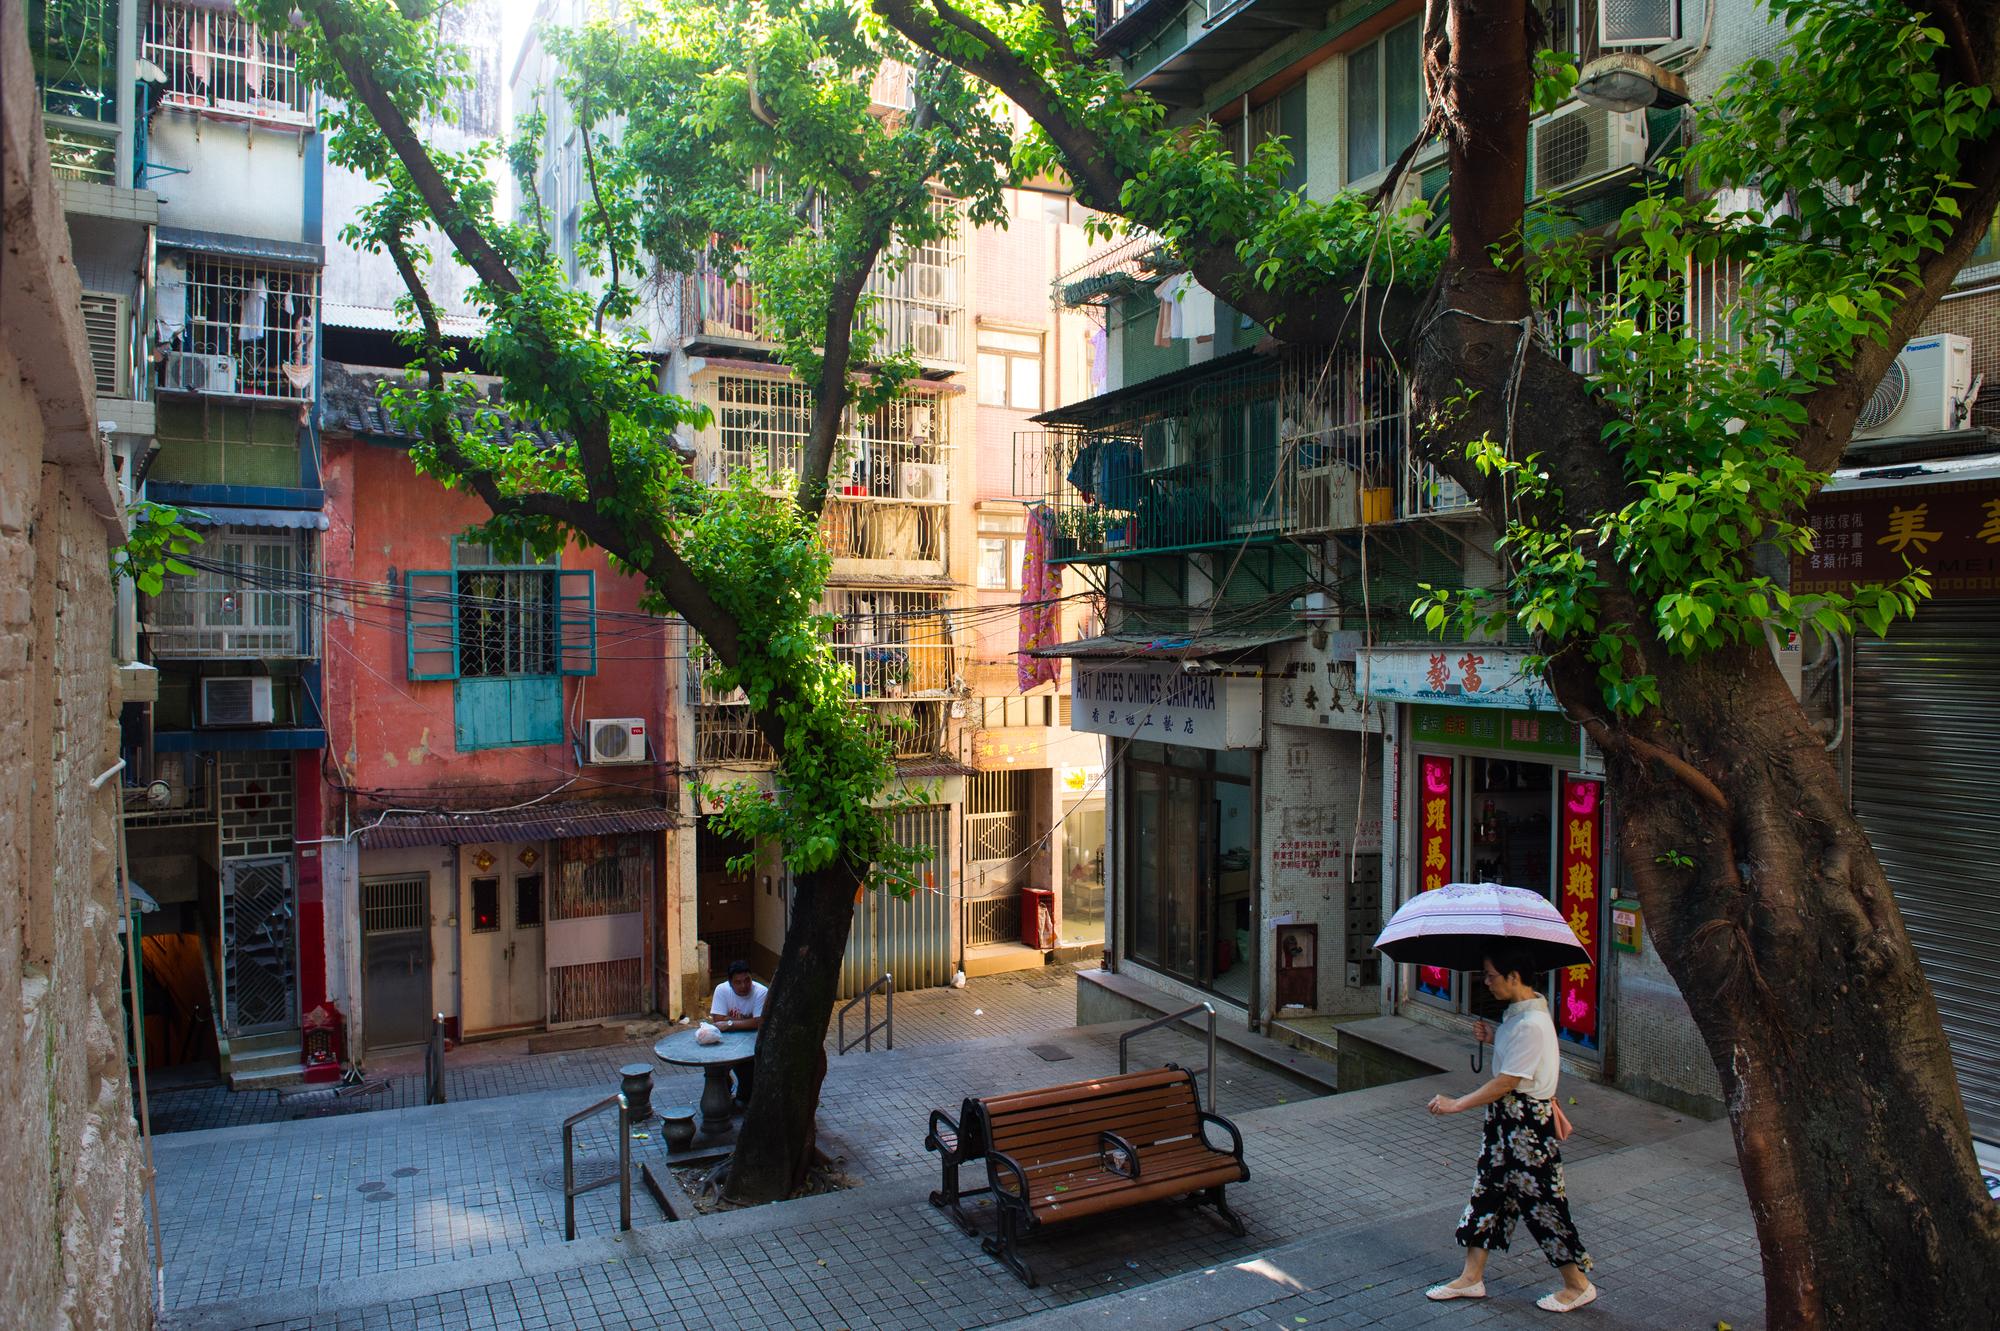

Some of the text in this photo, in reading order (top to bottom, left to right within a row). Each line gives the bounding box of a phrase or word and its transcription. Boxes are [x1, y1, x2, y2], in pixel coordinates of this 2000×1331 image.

[1906, 342, 1940, 353] Panasonic
[1809, 552, 1864, 569] 各類什項
[1076, 671, 1093, 699] ART
[1096, 672, 1123, 703] ARTES
[1128, 673, 1161, 705] CHINES
